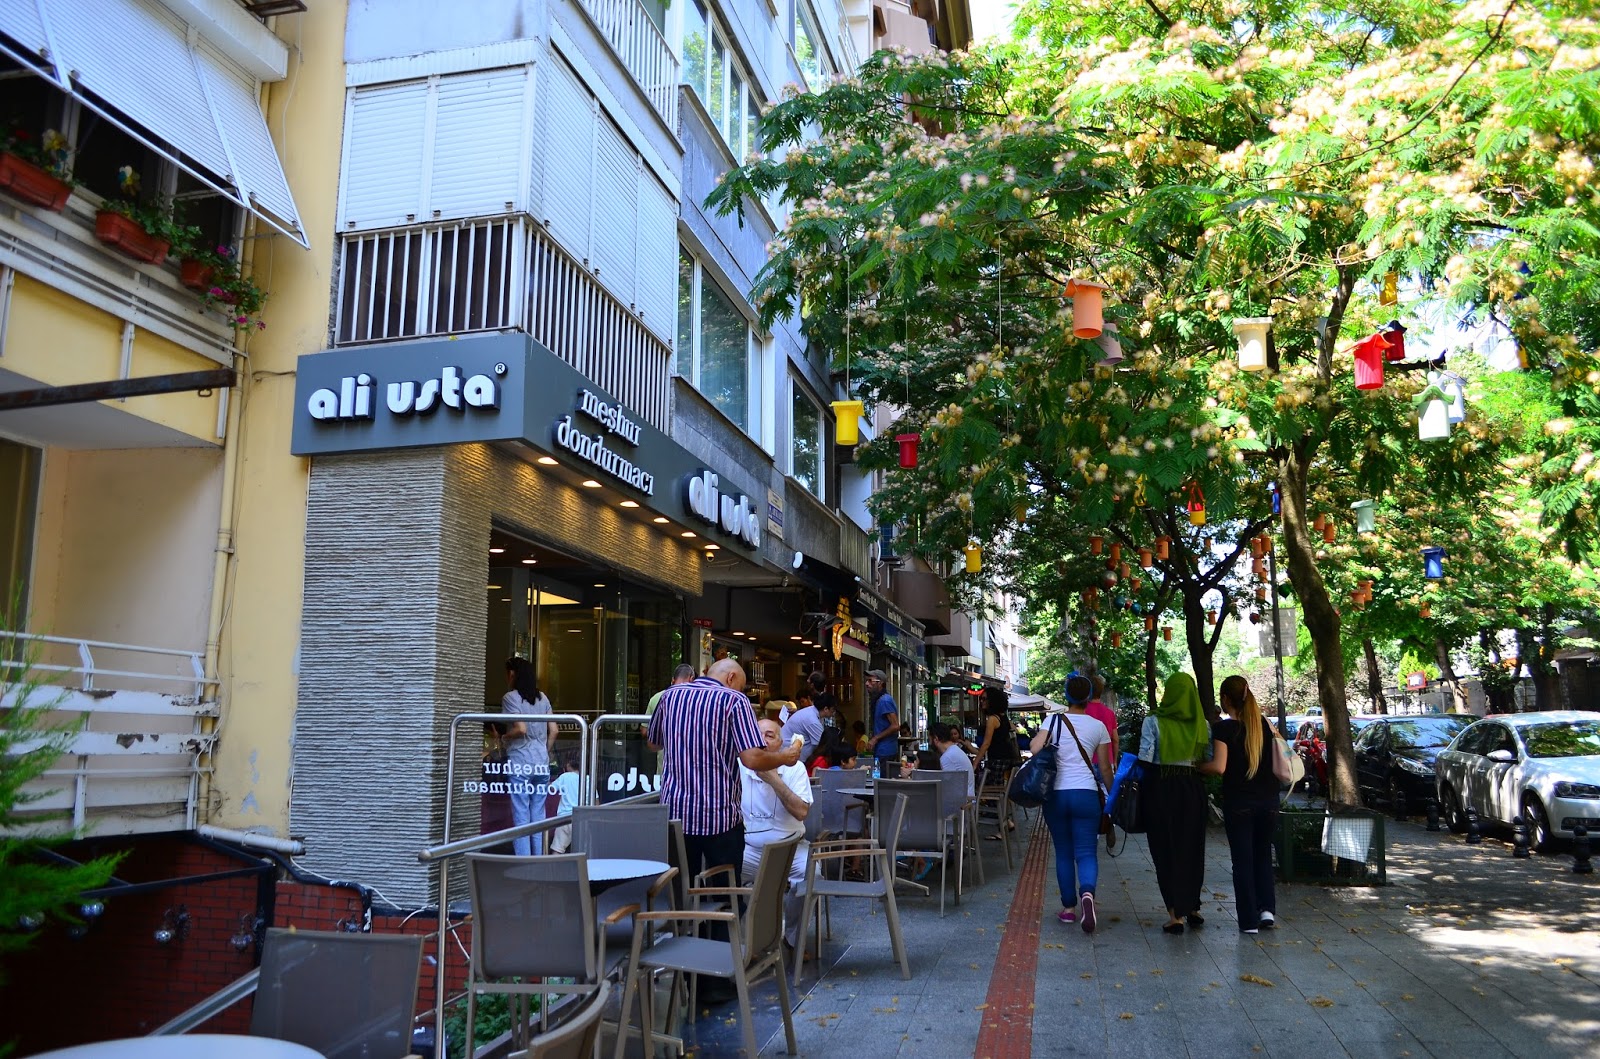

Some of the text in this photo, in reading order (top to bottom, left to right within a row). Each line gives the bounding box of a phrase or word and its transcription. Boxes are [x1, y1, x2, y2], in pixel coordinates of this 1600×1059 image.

[308, 373, 372, 419] ali
[387, 366, 496, 414] usta
[580, 389, 642, 446] meşhur
[557, 415, 654, 496] dondurmacı
[688, 470, 719, 524] ali
